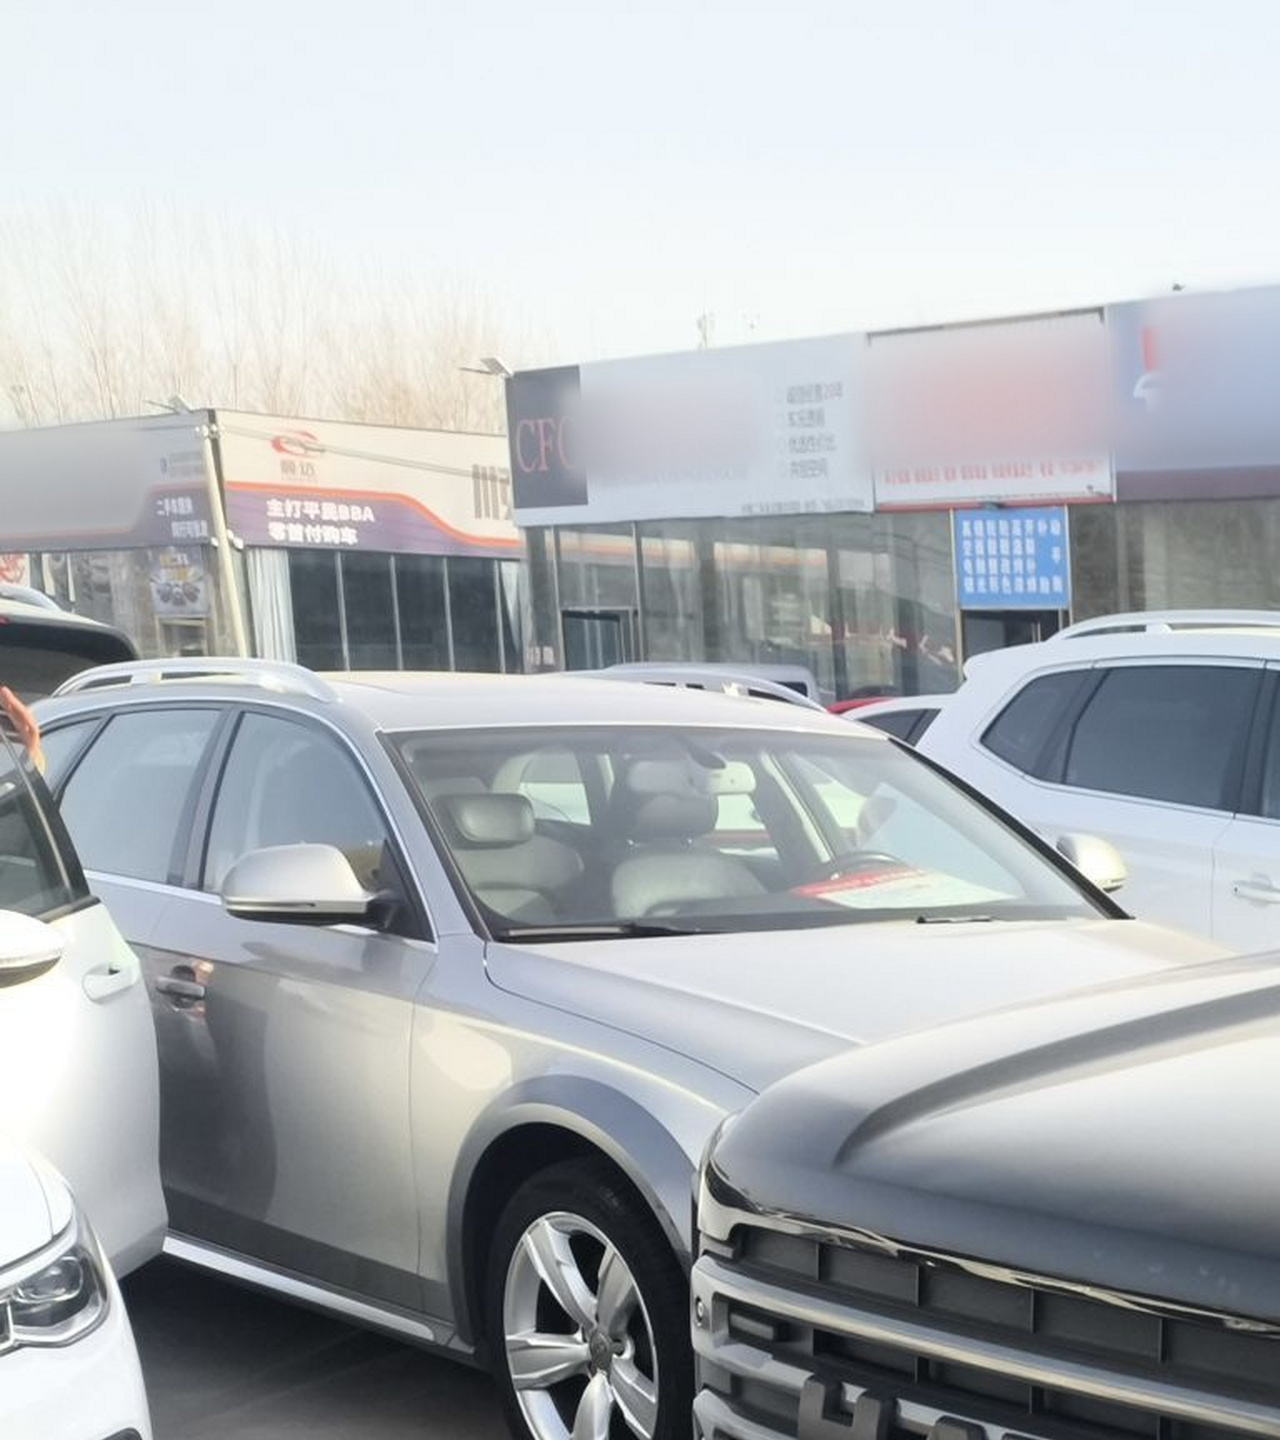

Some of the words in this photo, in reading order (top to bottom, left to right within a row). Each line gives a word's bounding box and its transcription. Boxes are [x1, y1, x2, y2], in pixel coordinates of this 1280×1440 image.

[266, 498, 376, 523] 主打平民BBA
[268, 521, 359, 545] 零首付购车
